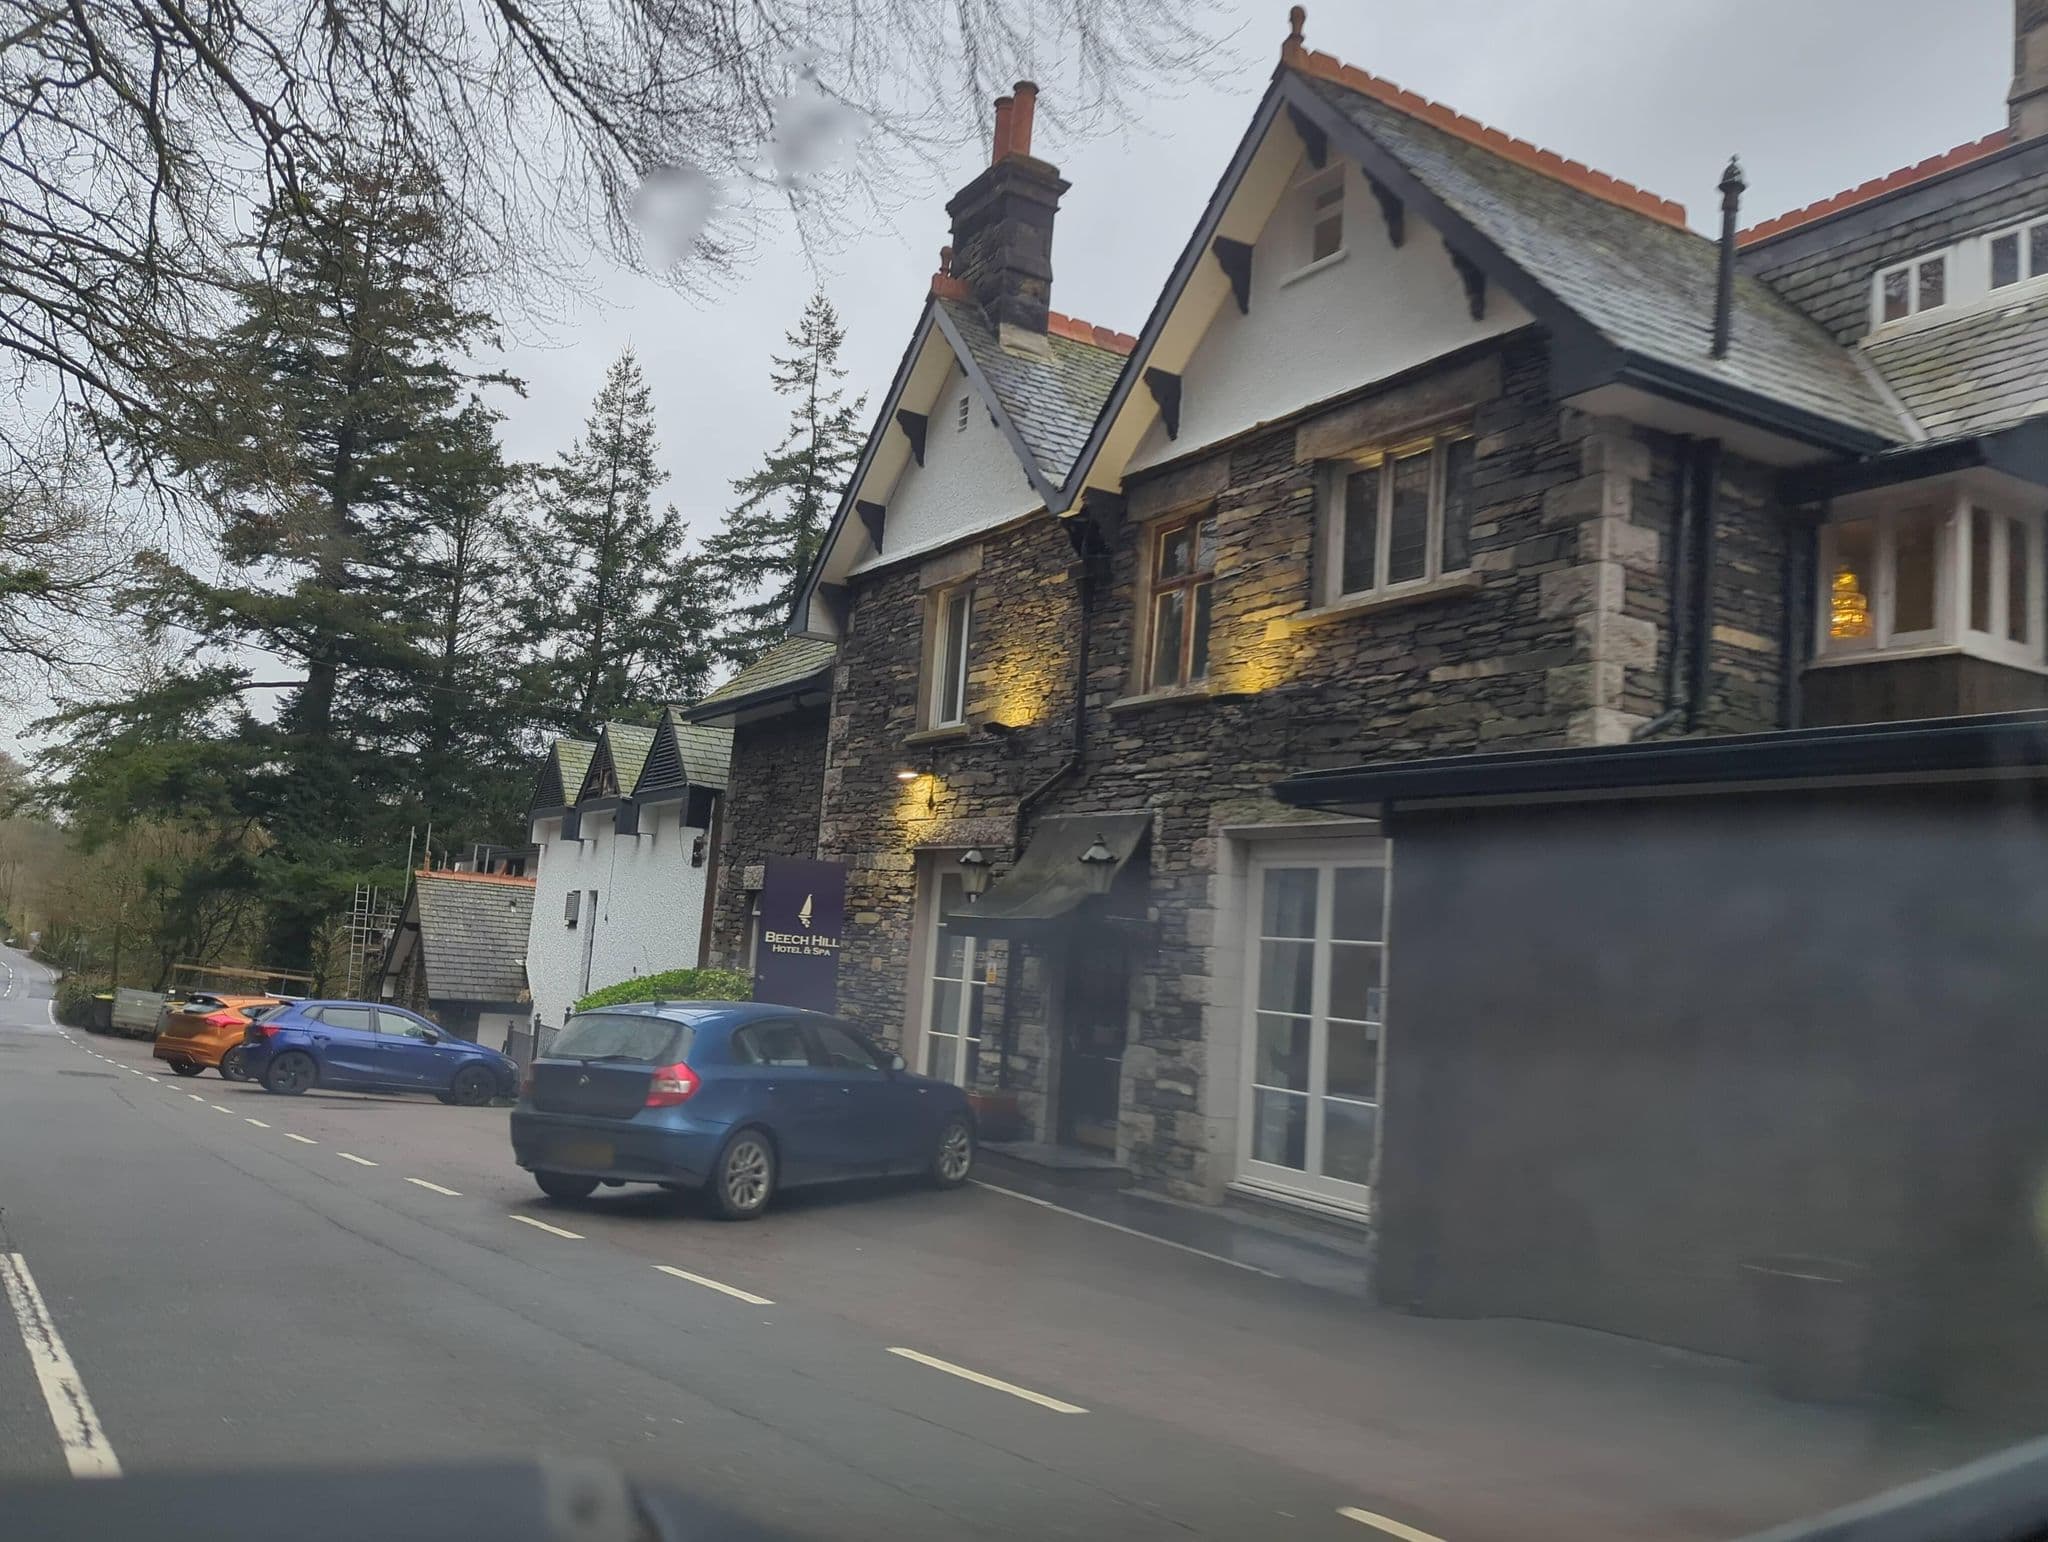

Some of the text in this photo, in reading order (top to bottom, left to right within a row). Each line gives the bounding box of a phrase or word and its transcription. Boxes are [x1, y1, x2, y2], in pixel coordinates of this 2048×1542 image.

[765, 931, 840, 947] BEECH HILL
[772, 944, 831, 956] HOTEL & SPA
